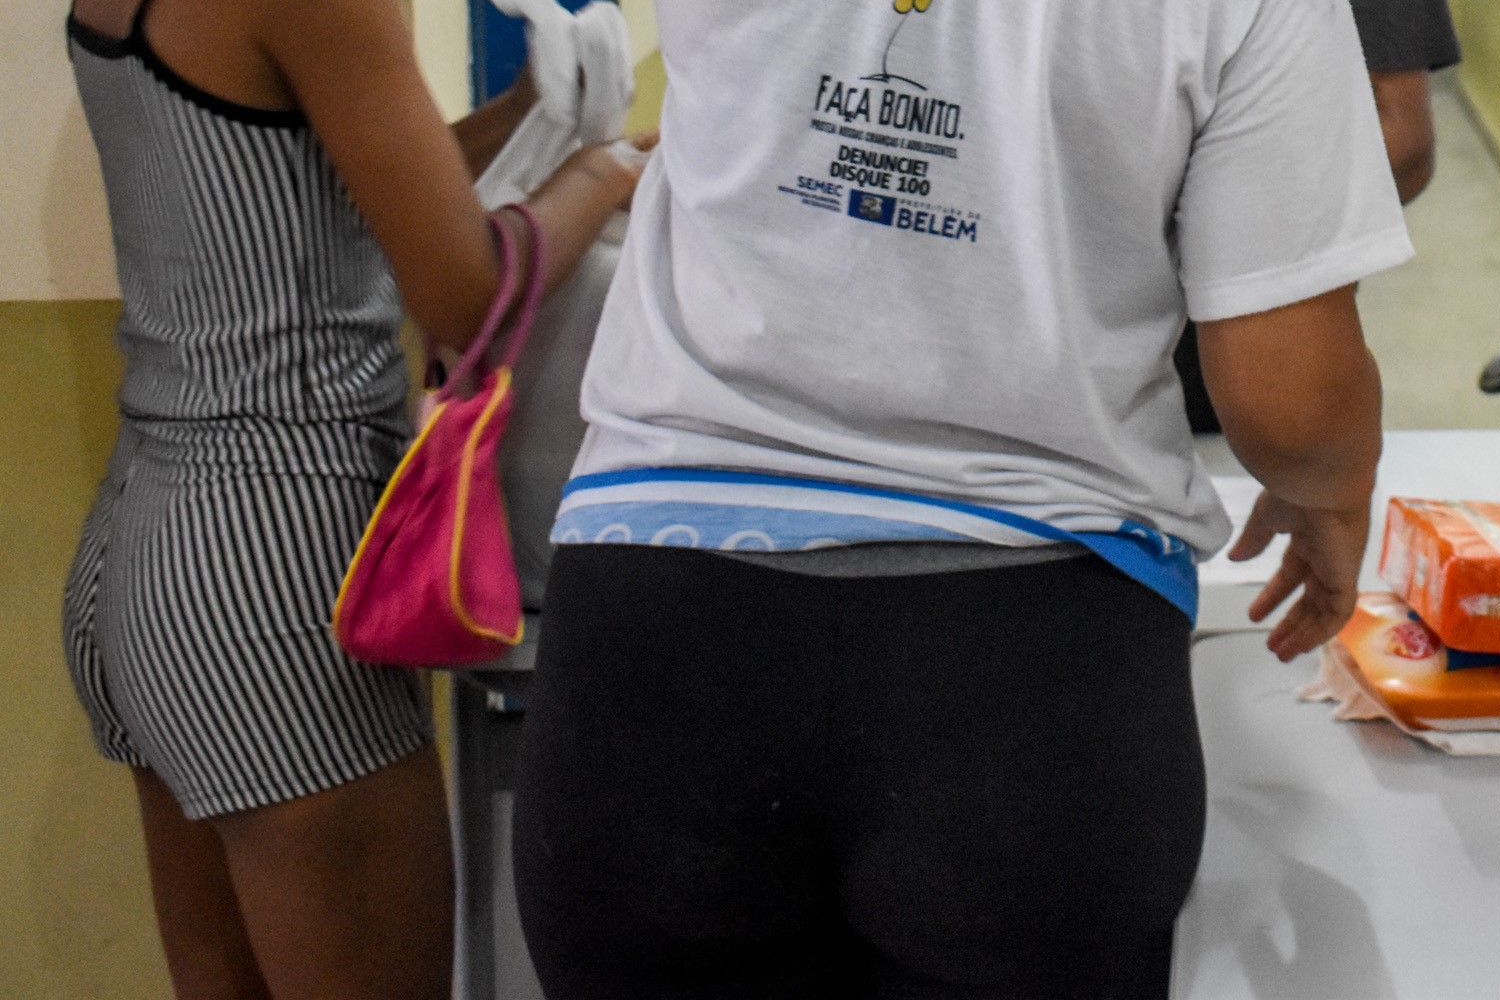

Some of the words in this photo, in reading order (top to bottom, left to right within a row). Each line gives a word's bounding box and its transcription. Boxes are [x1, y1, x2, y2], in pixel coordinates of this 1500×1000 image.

[814, 74, 870, 122] FAÇA
[878, 89, 965, 140] BONITO.
[838, 144, 929, 178] DENUNCIE!
[797, 175, 844, 197] SEMEC
[830, 161, 892, 189] DISQUE
[896, 175, 931, 196] 100
